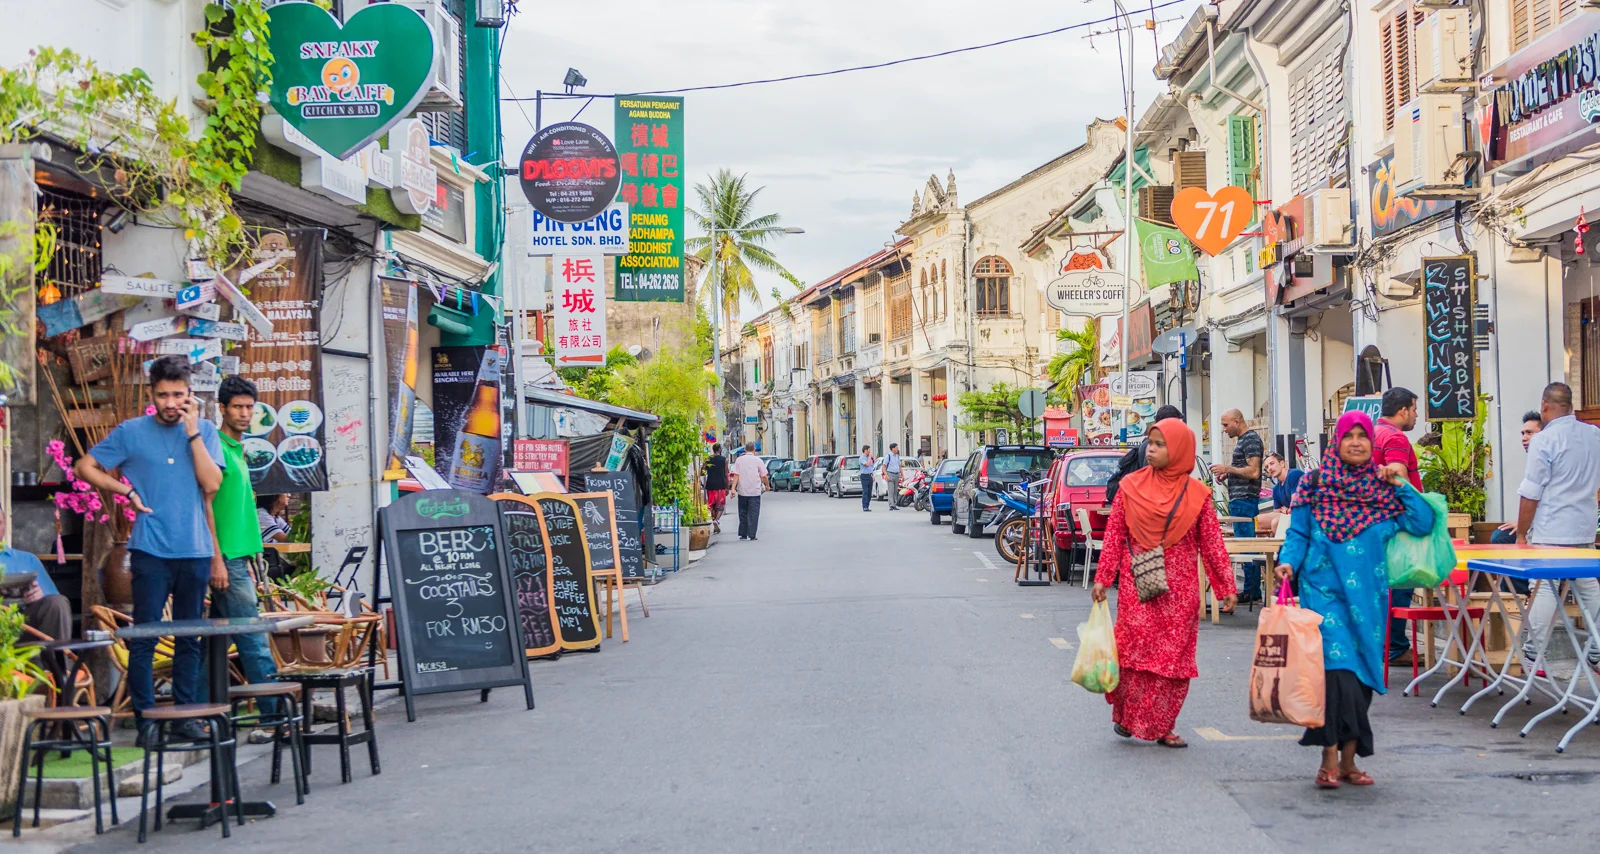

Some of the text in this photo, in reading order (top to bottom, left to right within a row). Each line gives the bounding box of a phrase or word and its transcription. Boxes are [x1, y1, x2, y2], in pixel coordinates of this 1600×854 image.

[301, 41, 379, 58] SNEAKY
[1481, 74, 1494, 88] KAFE
[296, 84, 388, 102] BAY CAFE
[305, 104, 376, 116] KITCHEN & BAR
[620, 100, 680, 110] PERSATUAN PENGANUT
[629, 110, 670, 119] AGAMA BUDDHA
[1510, 118, 1543, 143] RESTAURANT
[1549, 108, 1563, 123] CAFE
[540, 125, 586, 141] AIR-CONDITIONED
[591, 132, 606, 147] CABLE
[632, 213, 668, 226] PENANG
[1194, 200, 1235, 240] 71
[533, 236, 625, 246] HOTEL SDN. BHD.
[629, 242, 672, 254] BUDDHIST
[620, 255, 679, 268] ASSOCIATION
[126, 281, 175, 293] SALUTE
[638, 273, 661, 290] 04-262
[663, 274, 679, 290] 2626
[1057, 289, 1101, 300] WHEELER'S
[267, 310, 312, 319] MALAYSIA
[144, 322, 167, 335] PROST
[568, 318, 592, 331] 旅社
[559, 335, 601, 348] 有限公司
[1451, 267, 1473, 415] SHISHA & BAR
[277, 376, 311, 391] Coffee
[548, 444, 563, 452] HOTEL
[416, 497, 470, 517] Carlsberg
[554, 518, 573, 530] VIBE
[419, 531, 487, 555] BEER
[446, 552, 459, 563] 10
[460, 552, 474, 560] RM
[420, 563, 434, 571] ALL
[435, 563, 456, 571] NIGHT
[554, 591, 586, 604] COFFEE
[446, 598, 464, 618] 3
[561, 605, 582, 615] LOOK
[425, 615, 506, 638] FOR RM30
[560, 616, 583, 632] ME!
